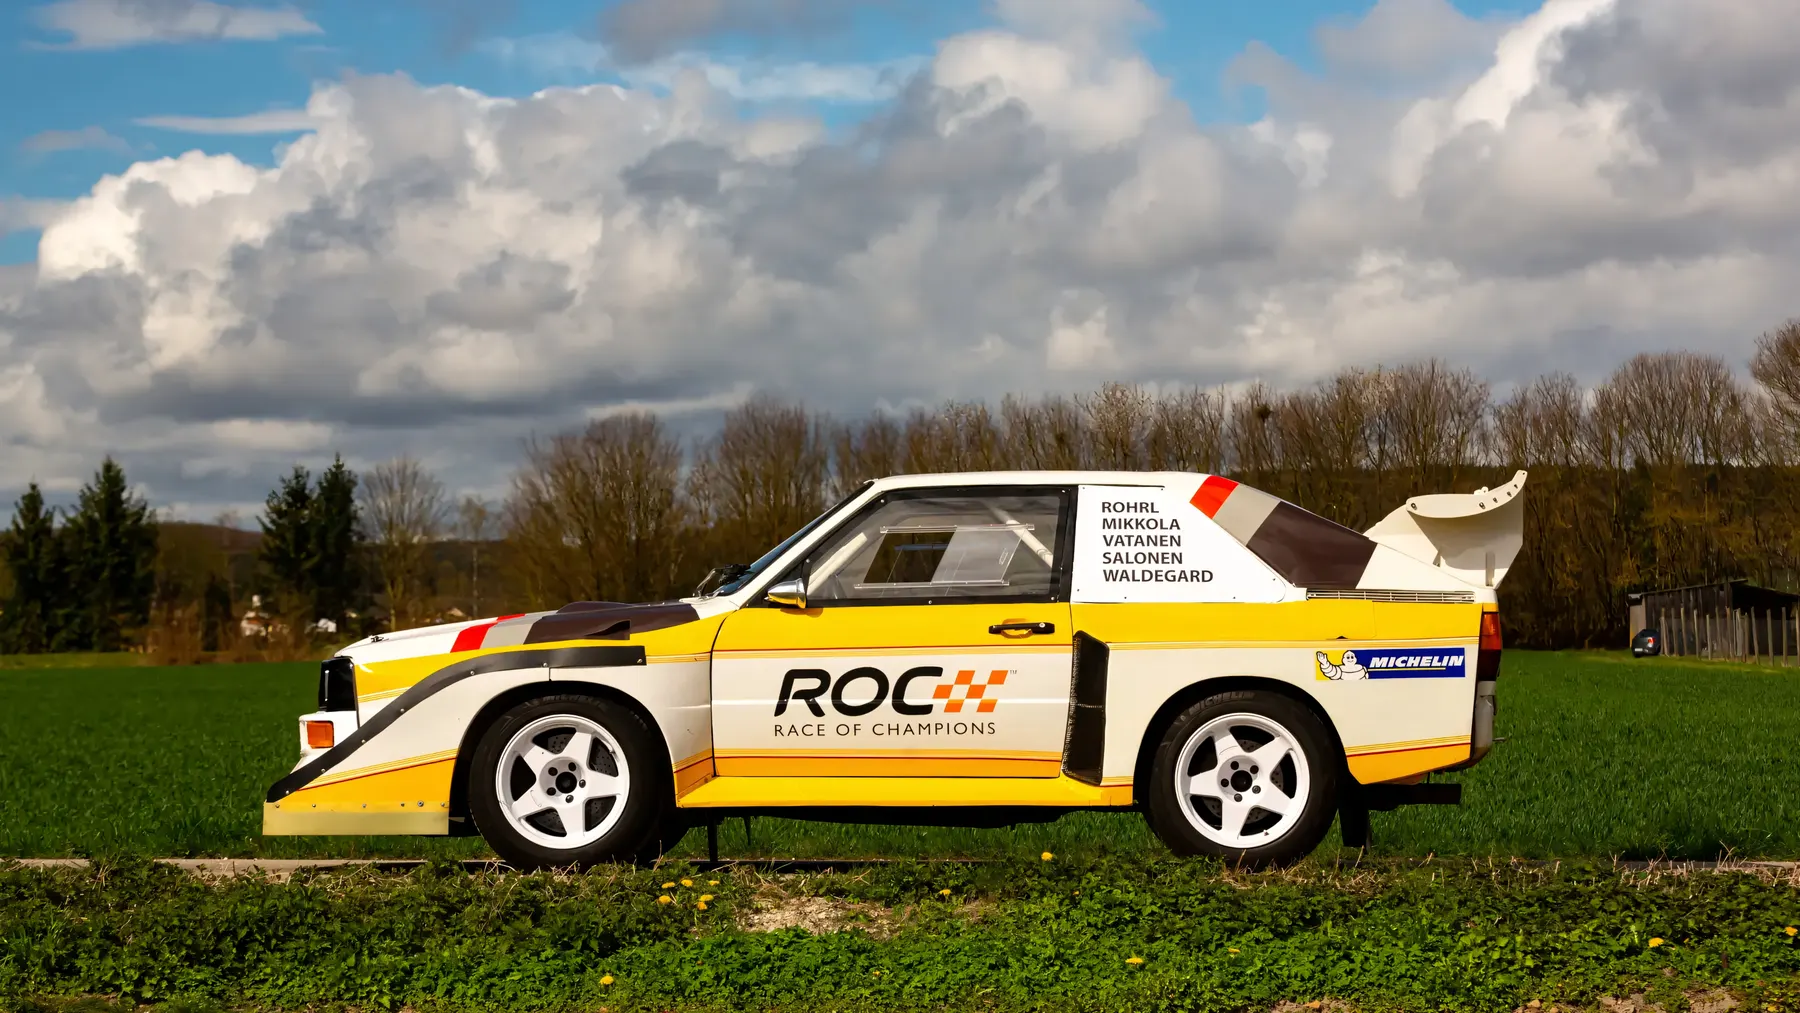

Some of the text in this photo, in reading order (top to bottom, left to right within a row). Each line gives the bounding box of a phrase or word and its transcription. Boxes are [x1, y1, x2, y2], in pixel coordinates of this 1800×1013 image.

[1101, 501, 1160, 514] ROHRL
[1102, 517, 1181, 531] MIKKOLA
[1102, 534, 1182, 547] VATANEN
[1102, 551, 1183, 565] SALONEN
[1102, 569, 1214, 583] WALDEGARD
[1369, 655, 1465, 668] MICHELIN
[773, 665, 944, 718] ROC
[774, 721, 996, 737] RACE OF CHAMPIONS
